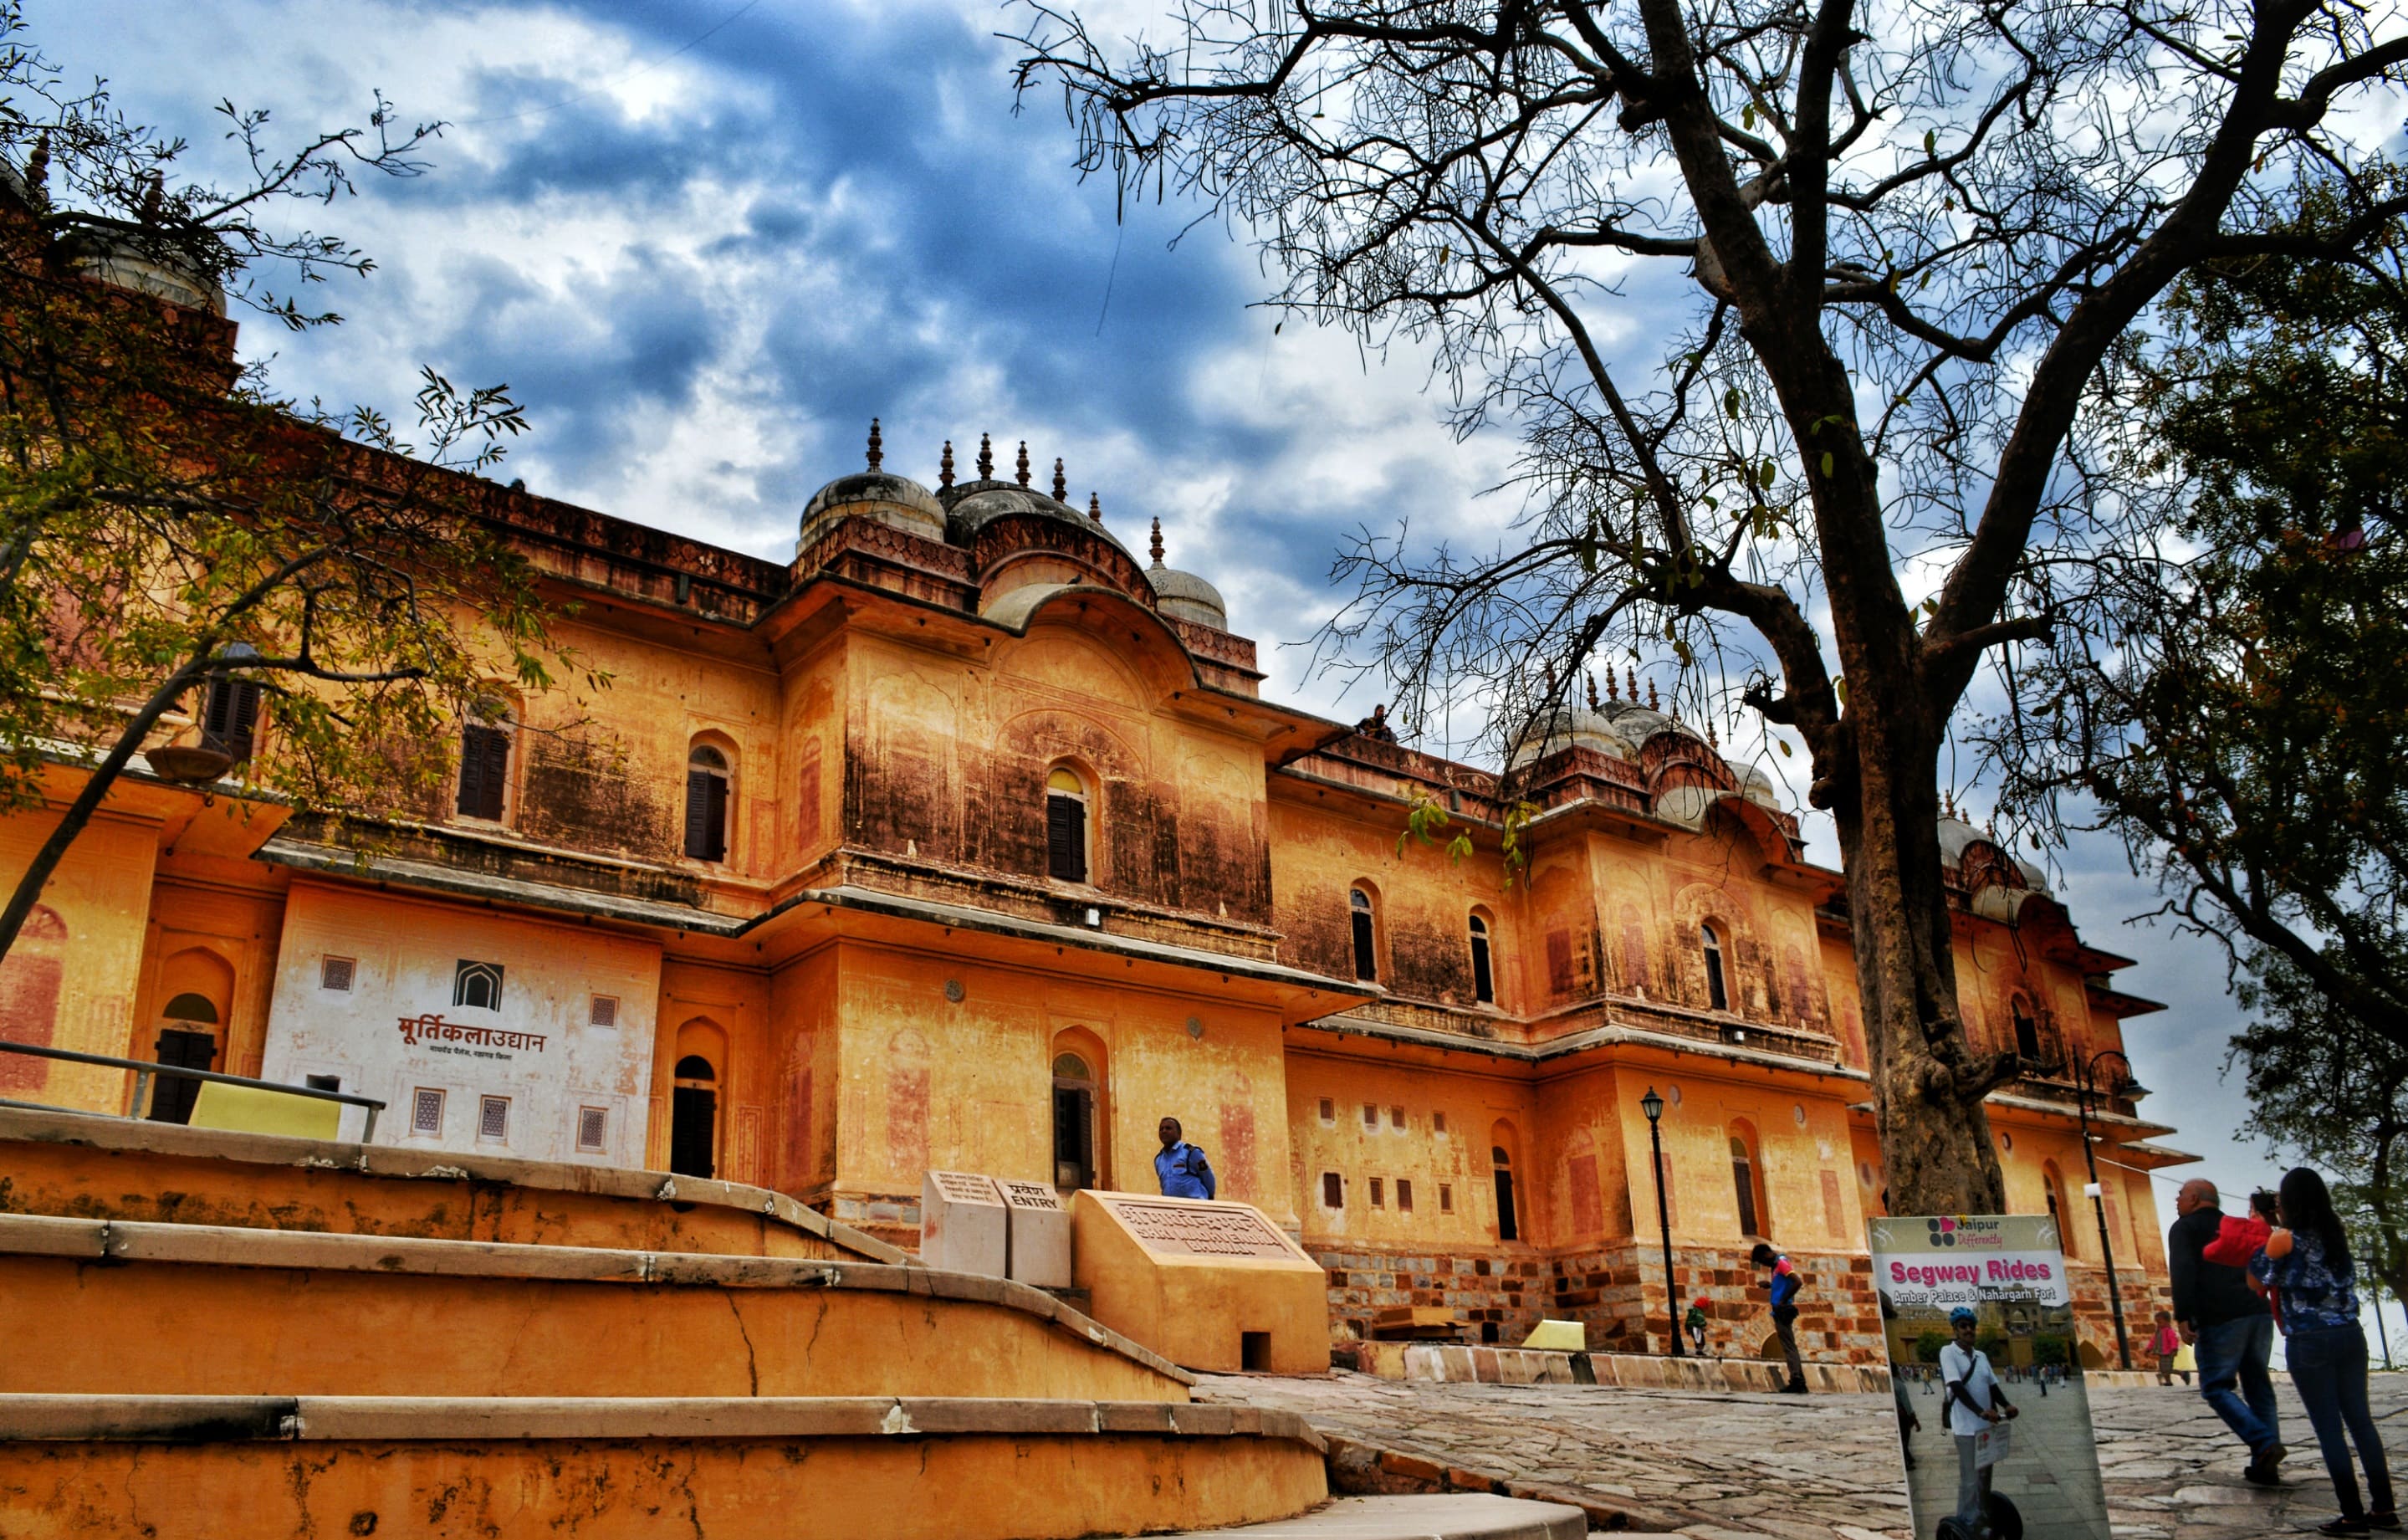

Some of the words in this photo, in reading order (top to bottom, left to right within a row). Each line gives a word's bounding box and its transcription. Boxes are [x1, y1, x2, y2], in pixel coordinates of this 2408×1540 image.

[1008, 1182, 1046, 1196] प्रवेश
[1011, 1195, 1058, 1210] ENTRY
[1956, 1218, 2000, 1232] Jaipur
[1957, 1233, 2003, 1248] Differently
[1890, 1261, 1980, 1287] Segway
[1986, 1259, 2052, 1282] Rides
[1894, 1290, 1928, 1304] Amber
[1930, 1289, 1966, 1302] Palace
[1968, 1290, 1976, 1302] &
[1978, 1288, 2033, 1302] Nahargarh
[2034, 1287, 2057, 1300] Fort
